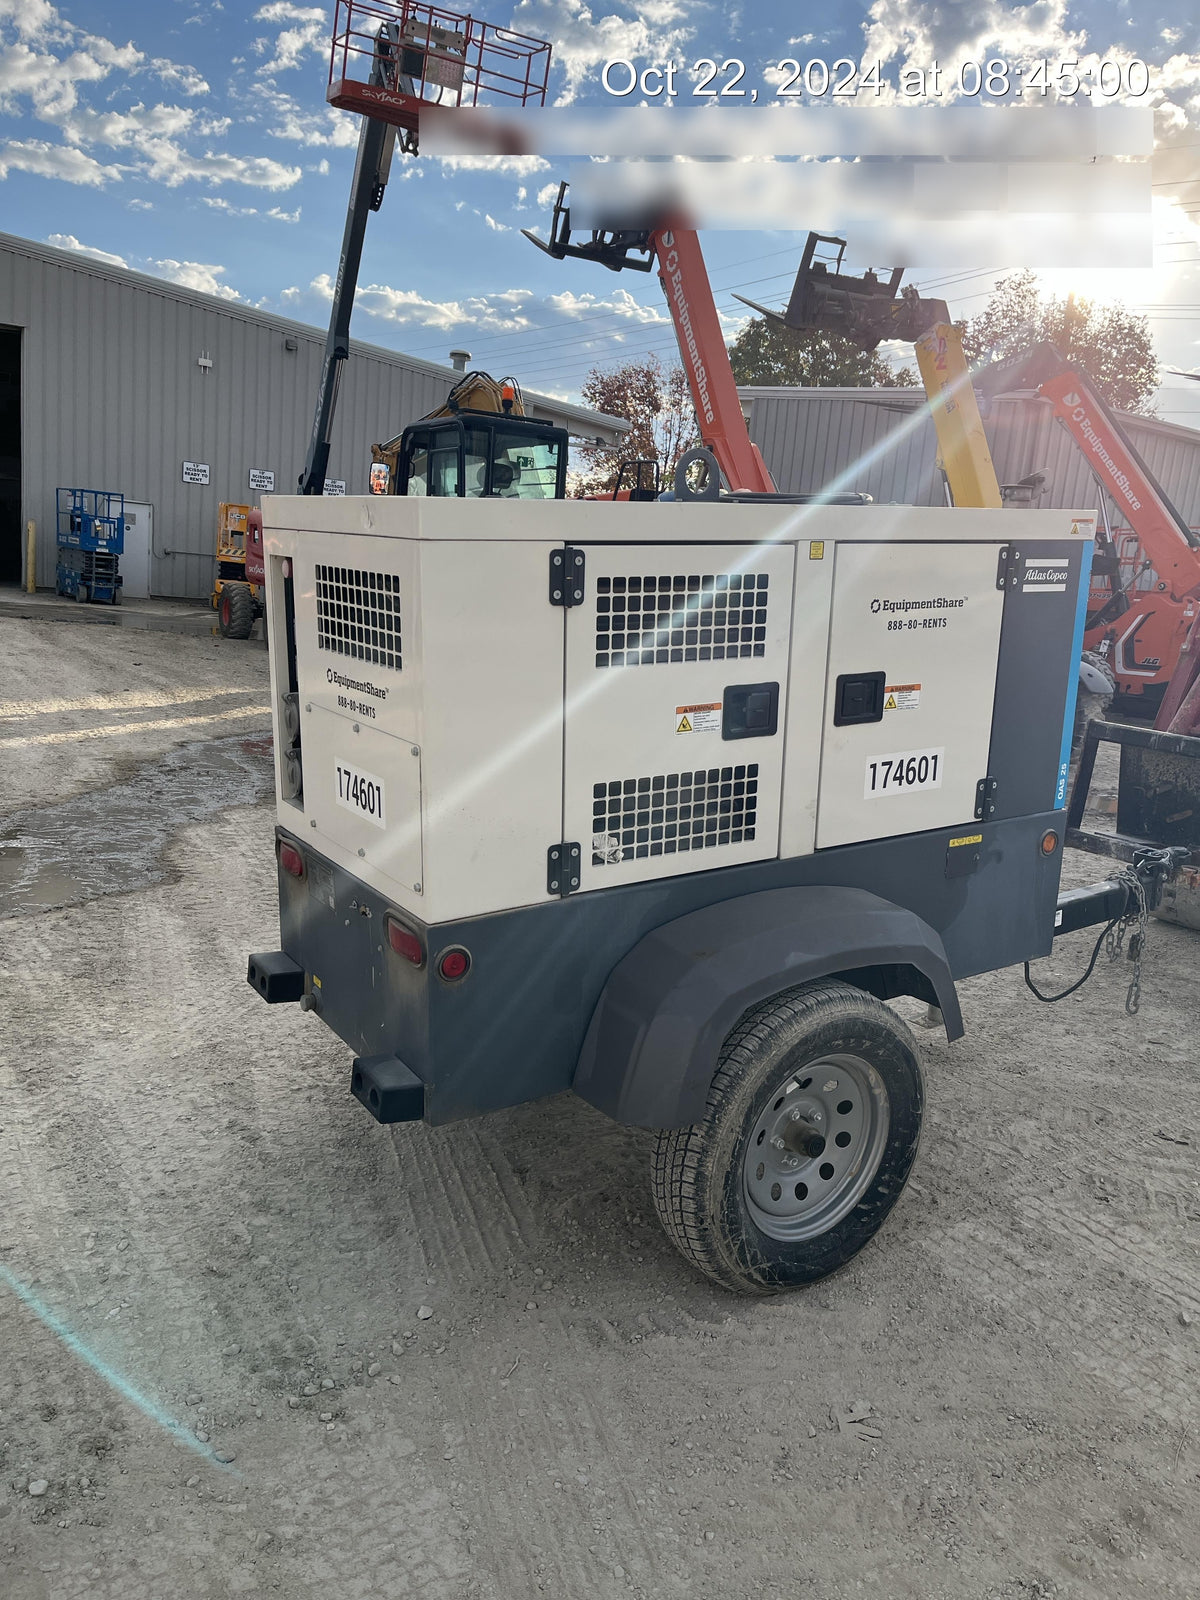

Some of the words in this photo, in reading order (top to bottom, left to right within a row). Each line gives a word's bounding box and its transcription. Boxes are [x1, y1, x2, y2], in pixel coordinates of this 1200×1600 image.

[361, 89, 406, 105] SKYJACK
[671, 269, 715, 425] EquipmentShare
[1080, 418, 1141, 511] EquipmentShare
[1024, 569, 1046, 581] Atlas
[1046, 569, 1068, 582] Copco
[887, 618, 947, 631] 888-80-RENTS
[1141, 657, 1160, 665] JLG
[338, 695, 376, 719] 888-80-RENTS
[687, 703, 715, 714] WARNING
[870, 754, 938, 791] 174601
[336, 766, 382, 819] 174601
